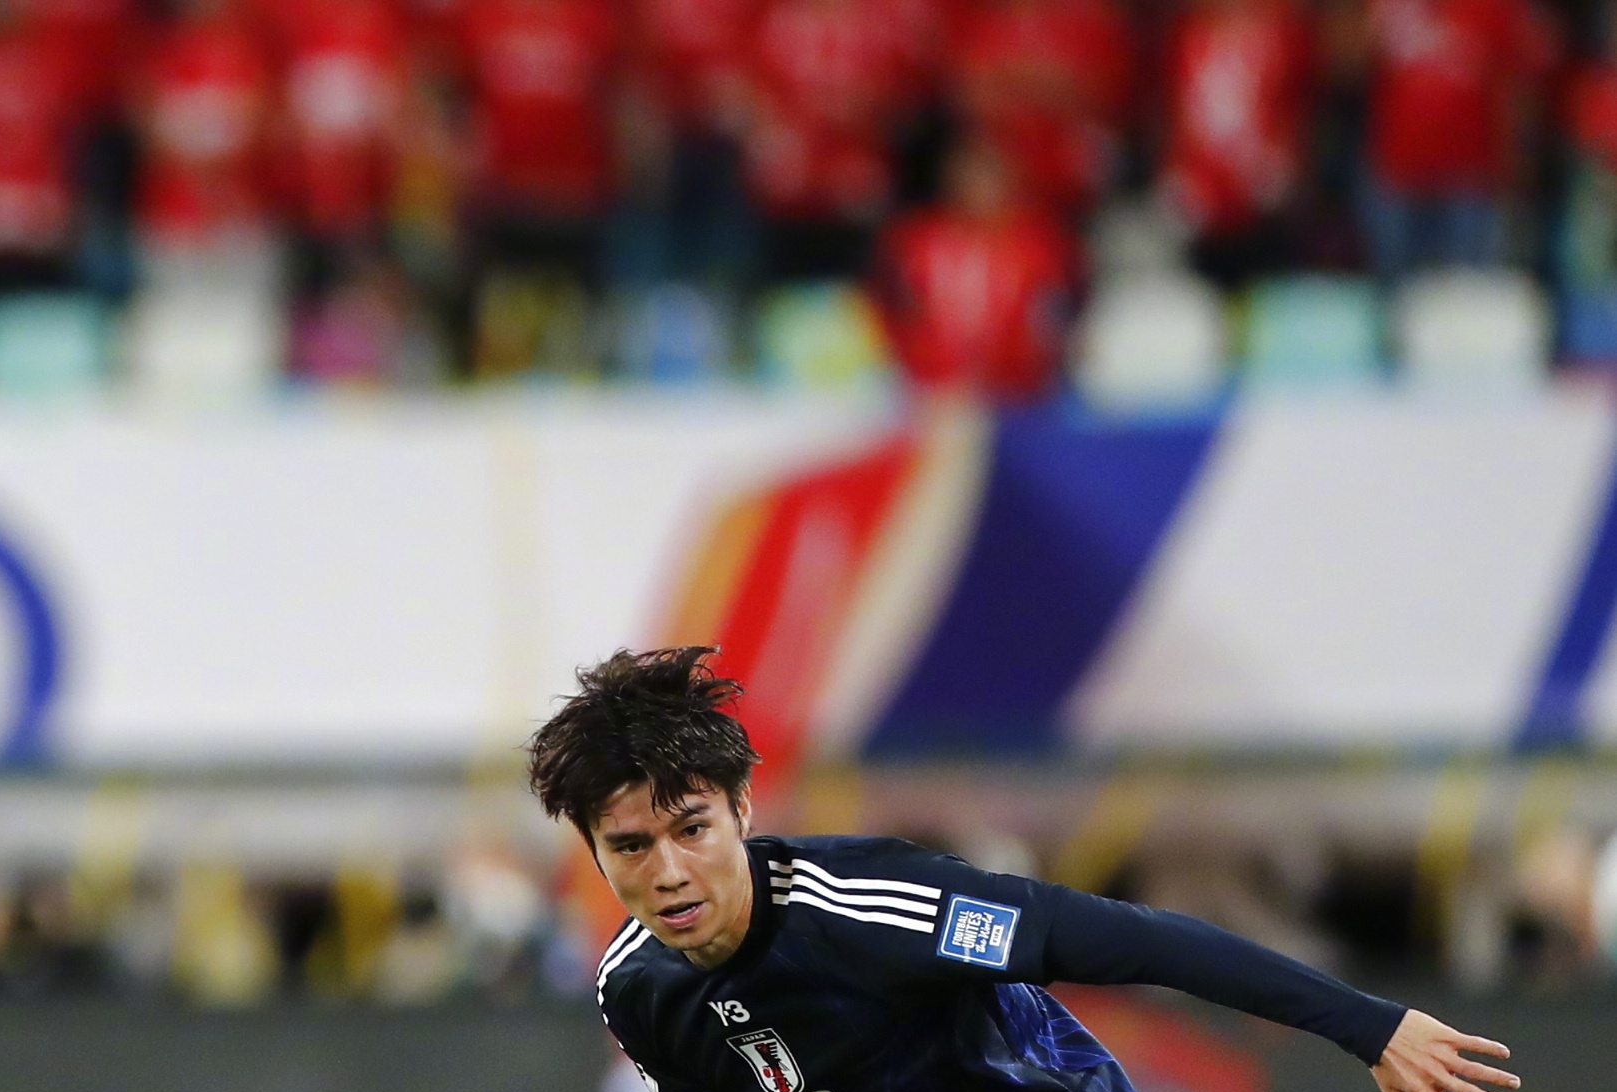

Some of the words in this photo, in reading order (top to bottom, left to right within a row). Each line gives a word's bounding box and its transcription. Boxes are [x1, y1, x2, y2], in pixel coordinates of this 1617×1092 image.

[952, 911, 969, 946] FOOTBALL
[962, 911, 982, 948] UNITES
[978, 912, 995, 939] World
[975, 939, 987, 953] the
[707, 1000, 750, 1026] Y-3
